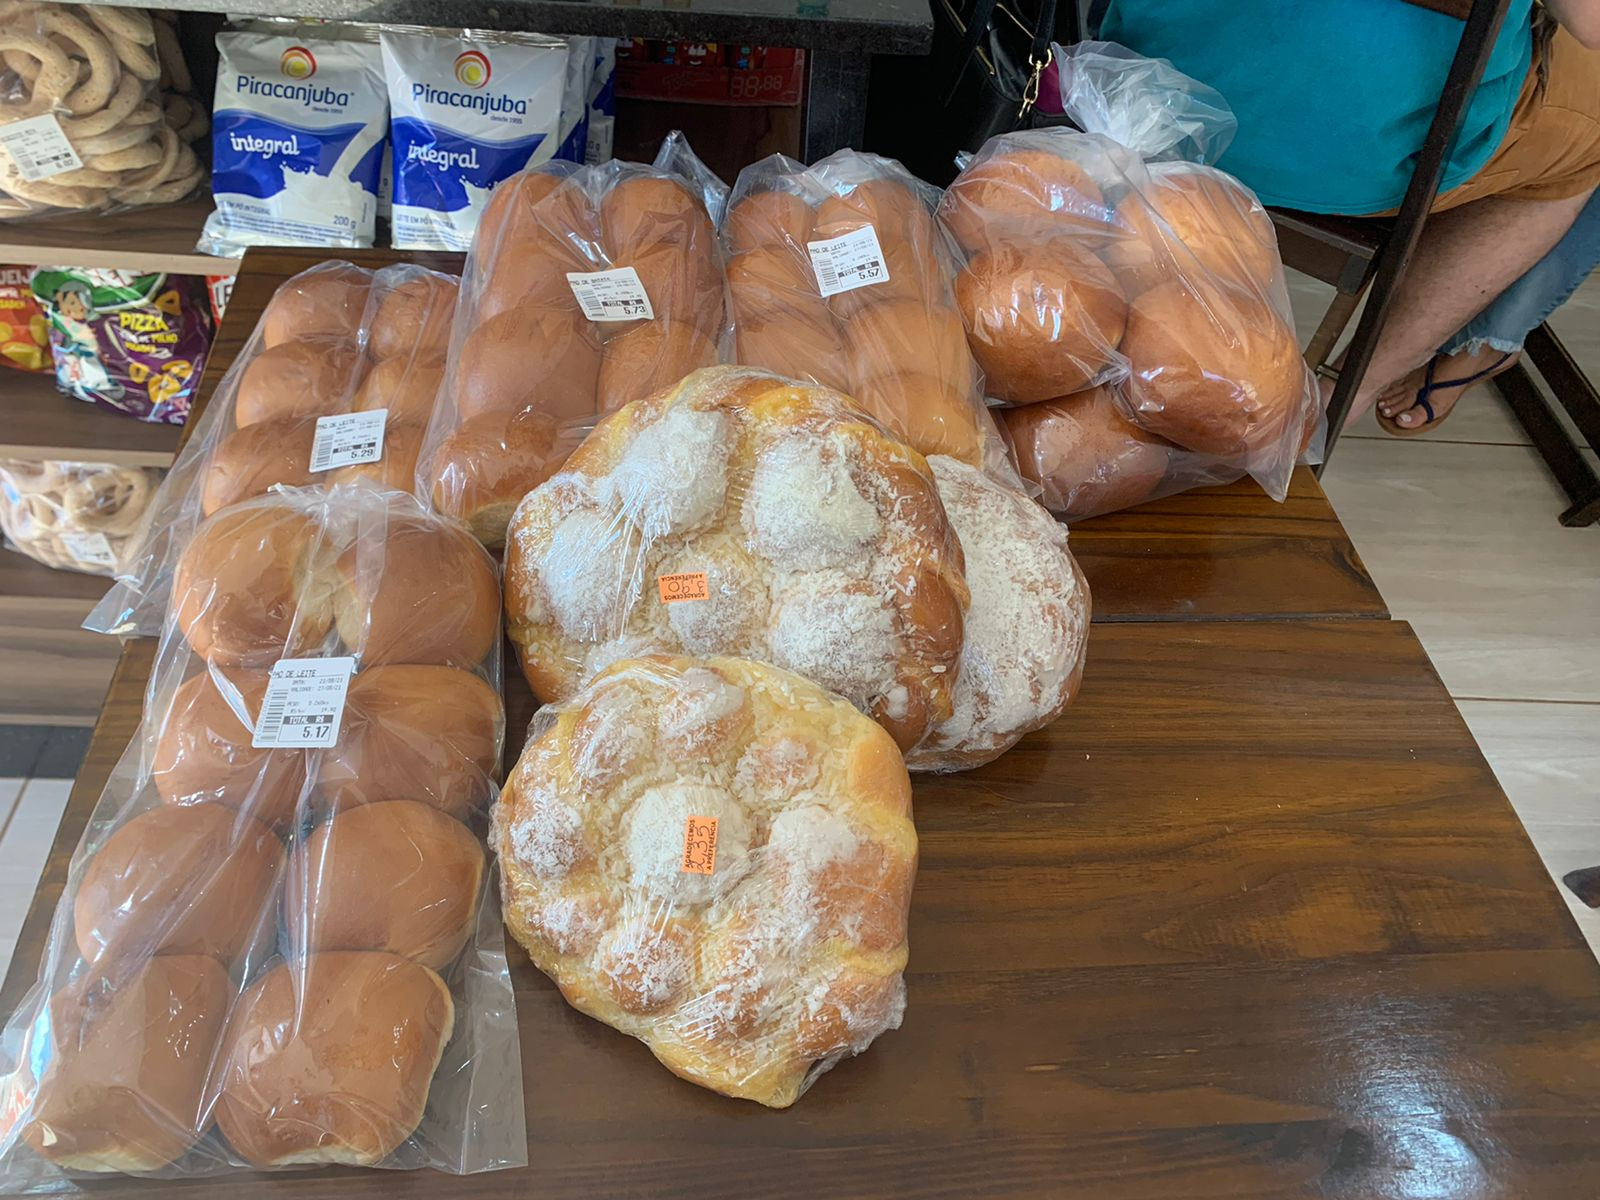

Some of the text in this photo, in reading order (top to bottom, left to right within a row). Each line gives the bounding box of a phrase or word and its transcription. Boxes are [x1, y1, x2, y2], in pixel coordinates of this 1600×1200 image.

[236, 76, 348, 106] Piracanjuba
[412, 83, 526, 115] Piracanjuba
[230, 132, 300, 159] integral
[408, 140, 480, 172] integral
[119, 312, 170, 332] PIZZA
[668, 579, 704, 594] 3,90
[296, 670, 316, 678] LEITE
[685, 819, 695, 868] AGRADECEMOS
[707, 821, 716, 864] PREFERENCIA
